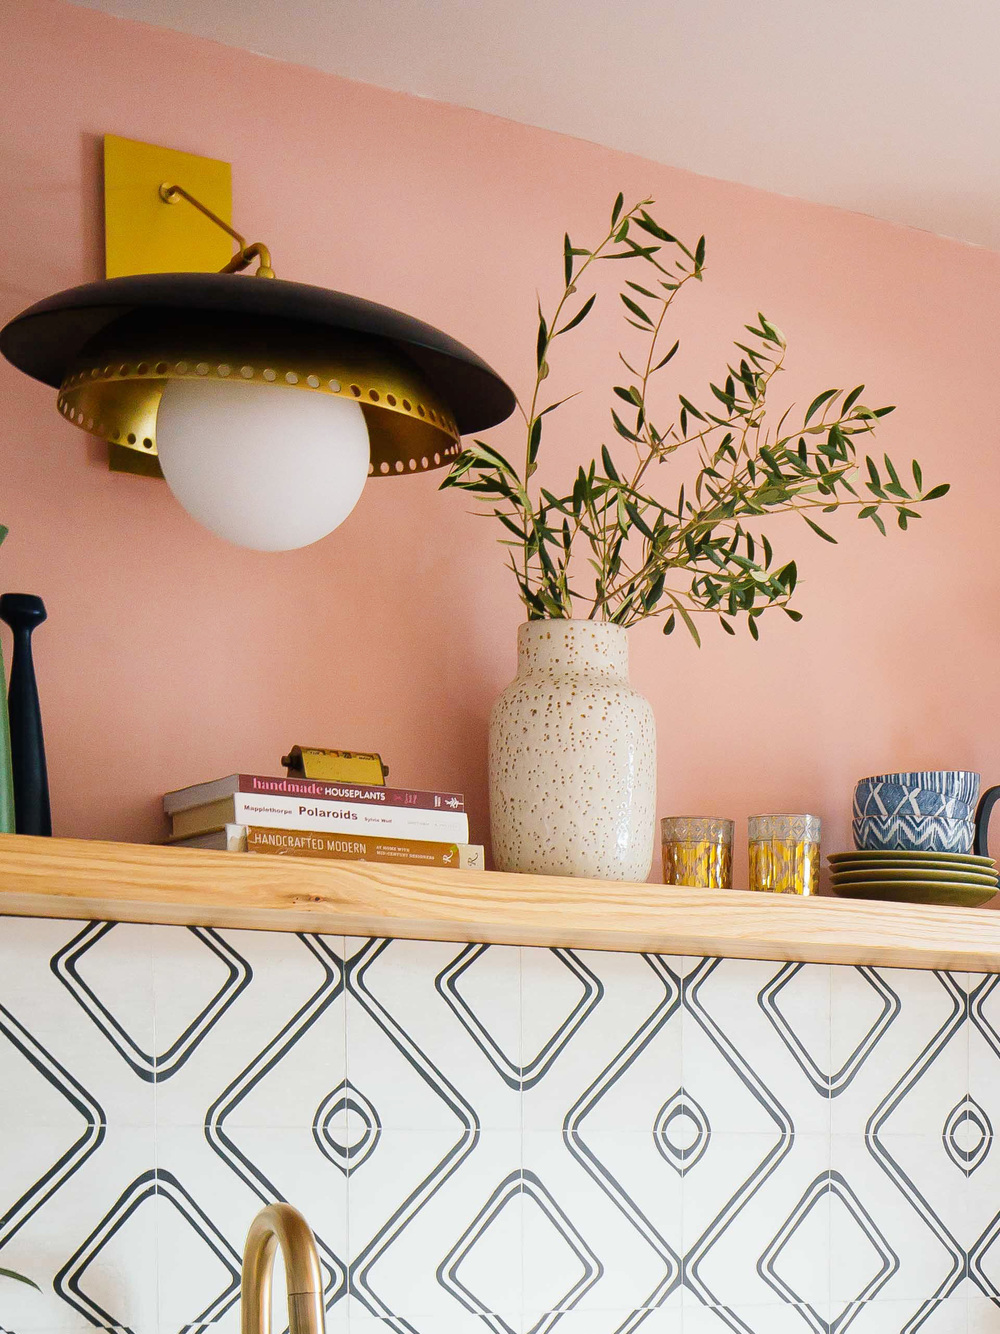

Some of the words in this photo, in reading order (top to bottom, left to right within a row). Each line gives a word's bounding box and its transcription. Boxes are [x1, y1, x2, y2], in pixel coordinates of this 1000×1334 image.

[253, 777, 323, 794] handmade
[324, 787, 386, 801] HOUSEPLANTS
[243, 804, 293, 815] Mapplethorpe
[298, 806, 358, 820] Polaroids
[254, 833, 324, 850] HANDCRAFTED
[327, 840, 367, 854] MODERN
